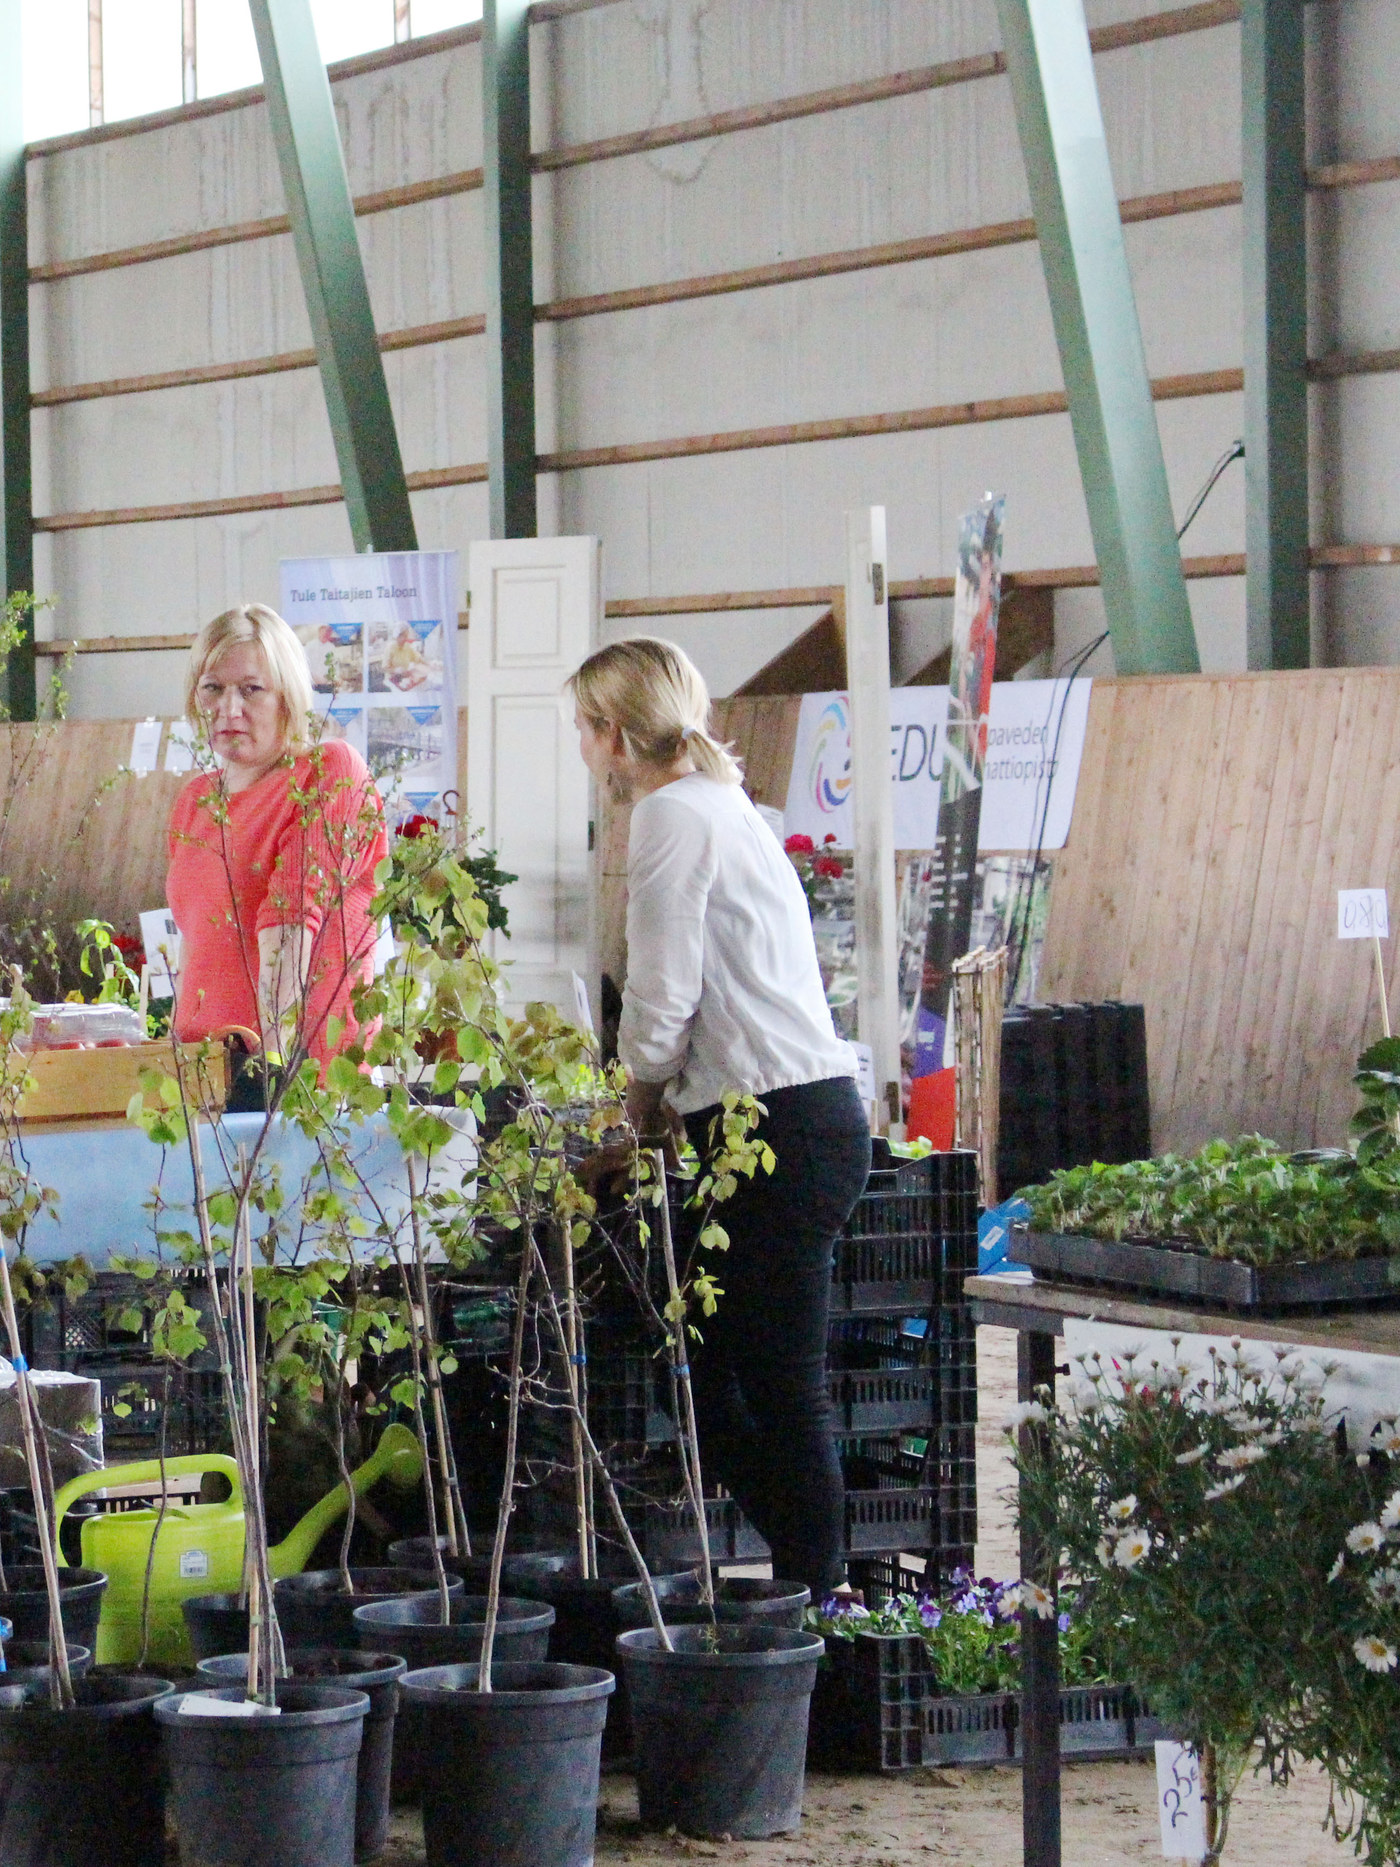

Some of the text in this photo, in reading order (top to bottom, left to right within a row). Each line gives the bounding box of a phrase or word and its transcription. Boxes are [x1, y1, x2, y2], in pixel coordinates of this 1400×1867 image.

[290, 585, 417, 603] Tule Taitajien Taloon
